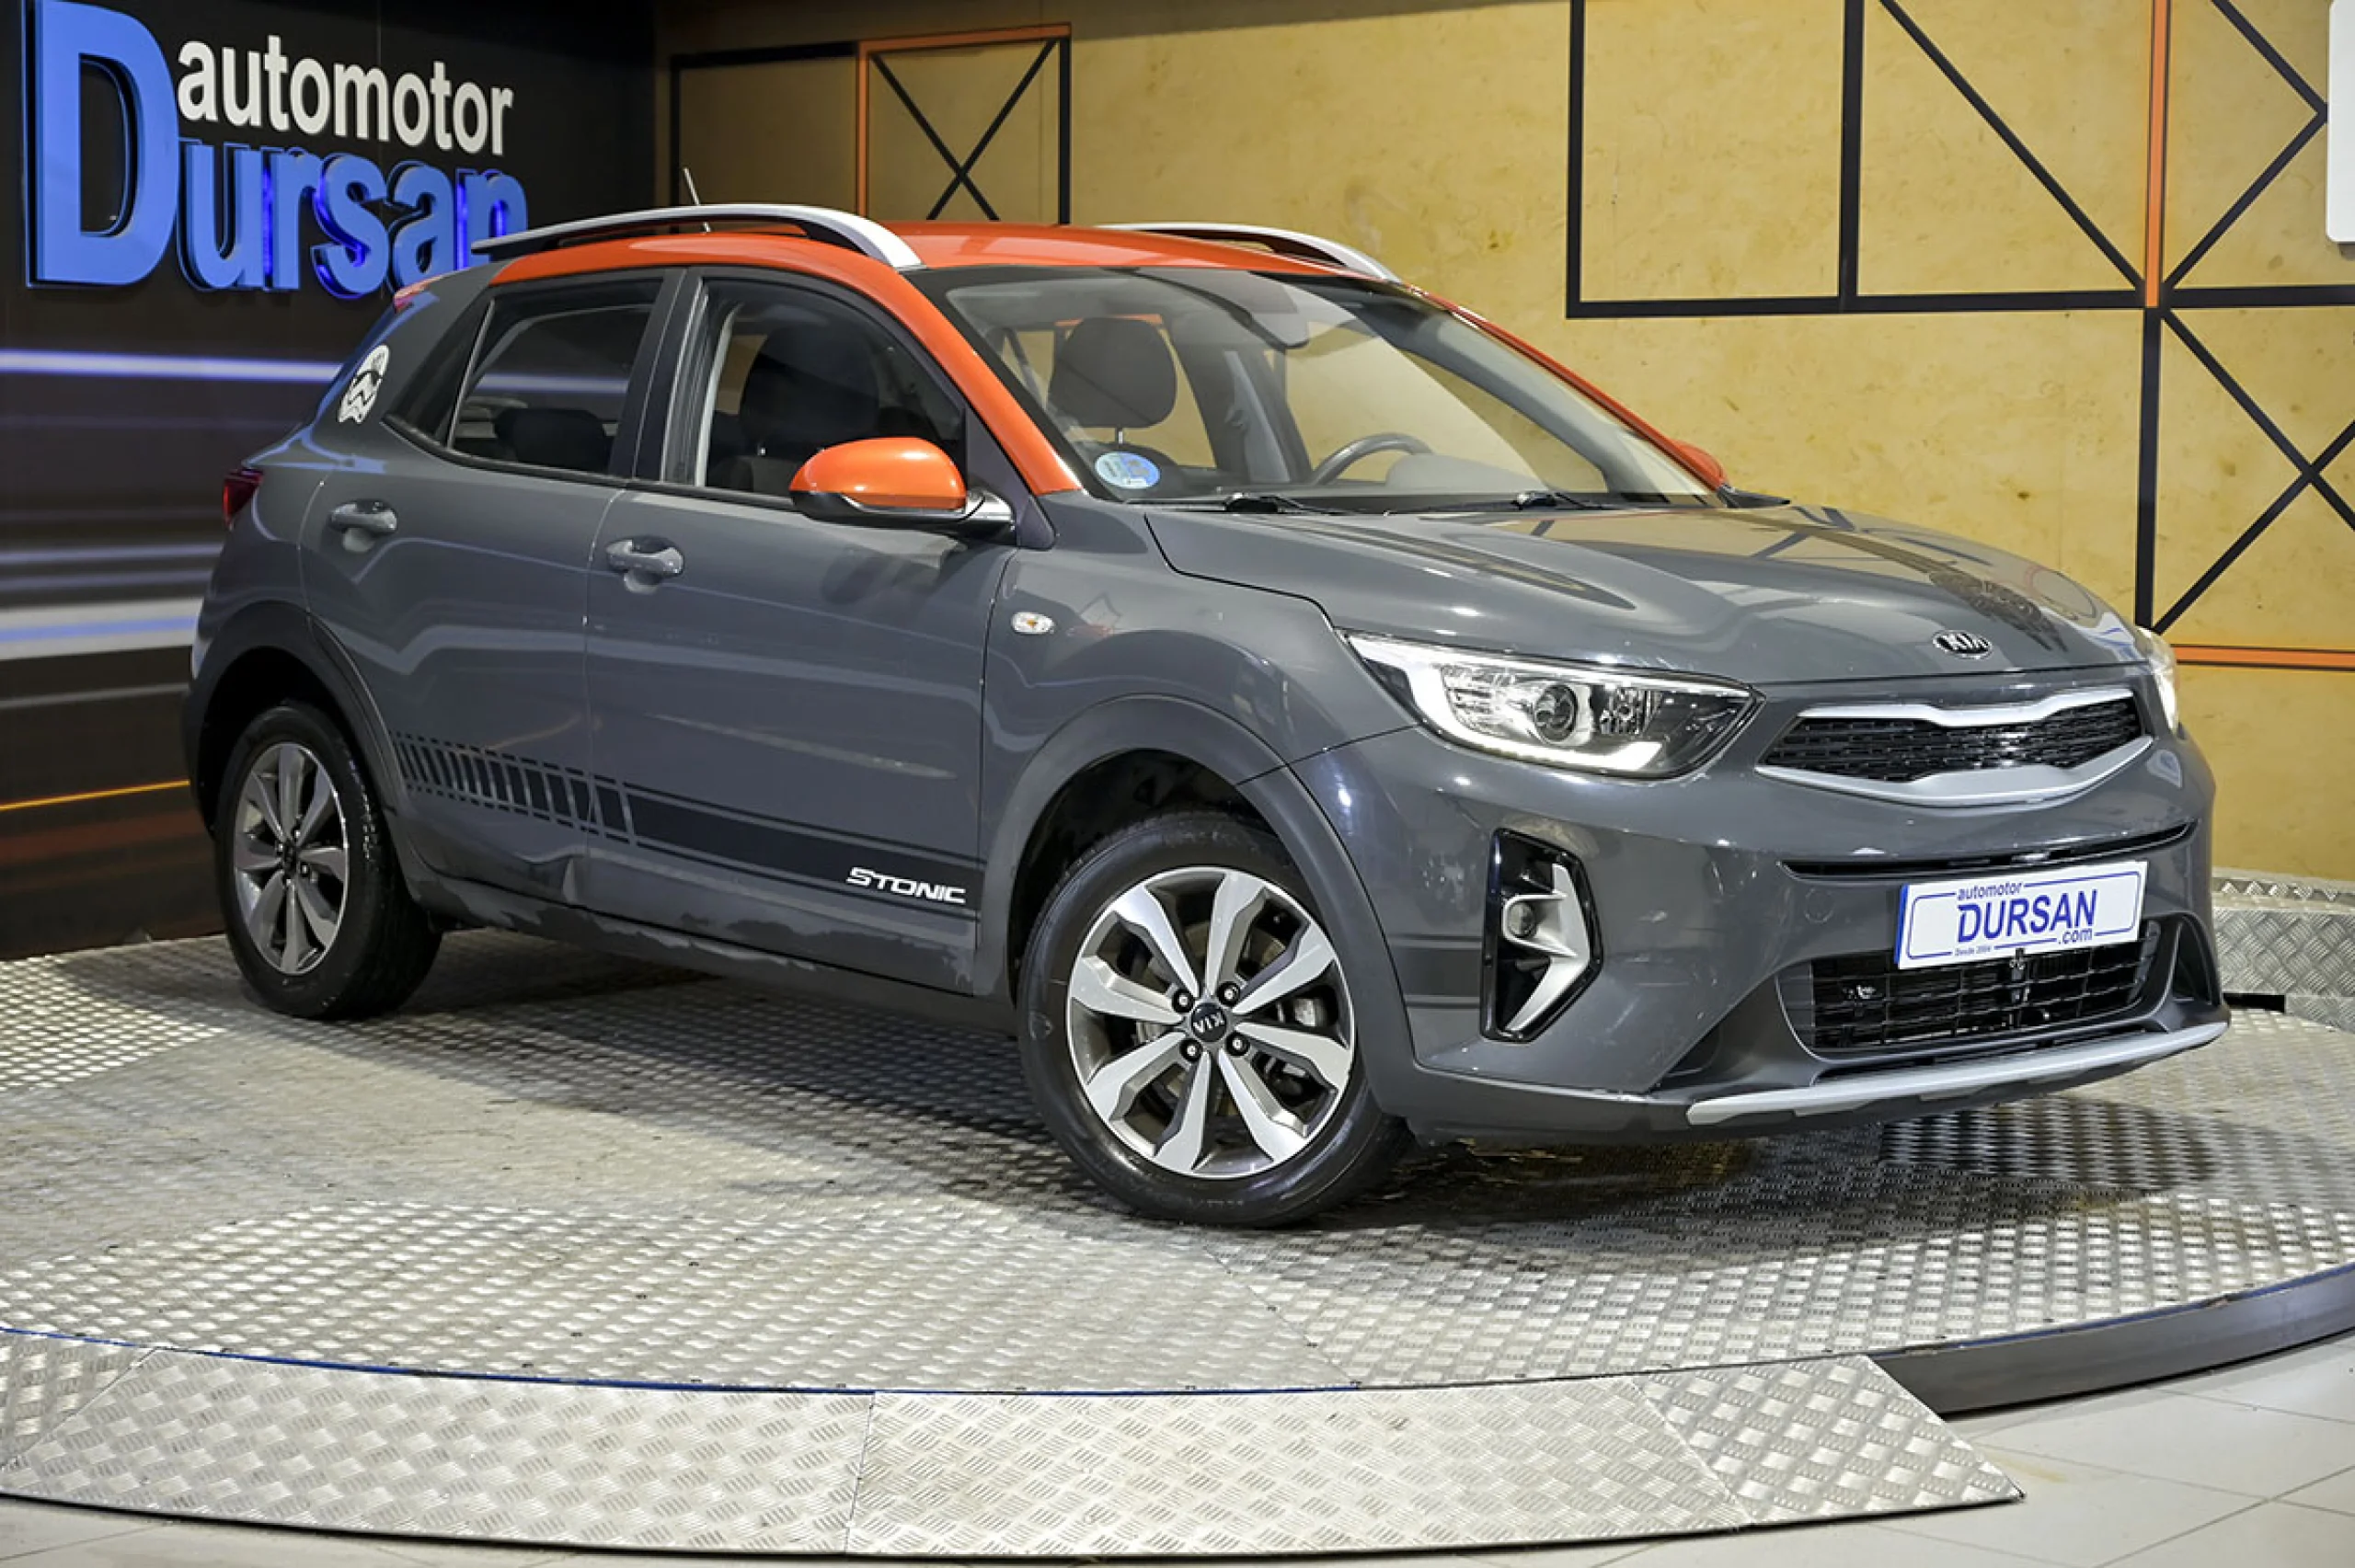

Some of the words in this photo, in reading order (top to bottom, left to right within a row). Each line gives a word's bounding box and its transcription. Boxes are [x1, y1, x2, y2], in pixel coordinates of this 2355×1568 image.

[178, 35, 512, 155] automotor
[24, 0, 528, 299] Dursan
[846, 866, 966, 904] STONIC
[1957, 882, 2023, 900] automotor
[1958, 888, 2097, 943] DURSAN
[2058, 928, 2093, 944] .com
[1192, 1013, 1224, 1033] KIA
